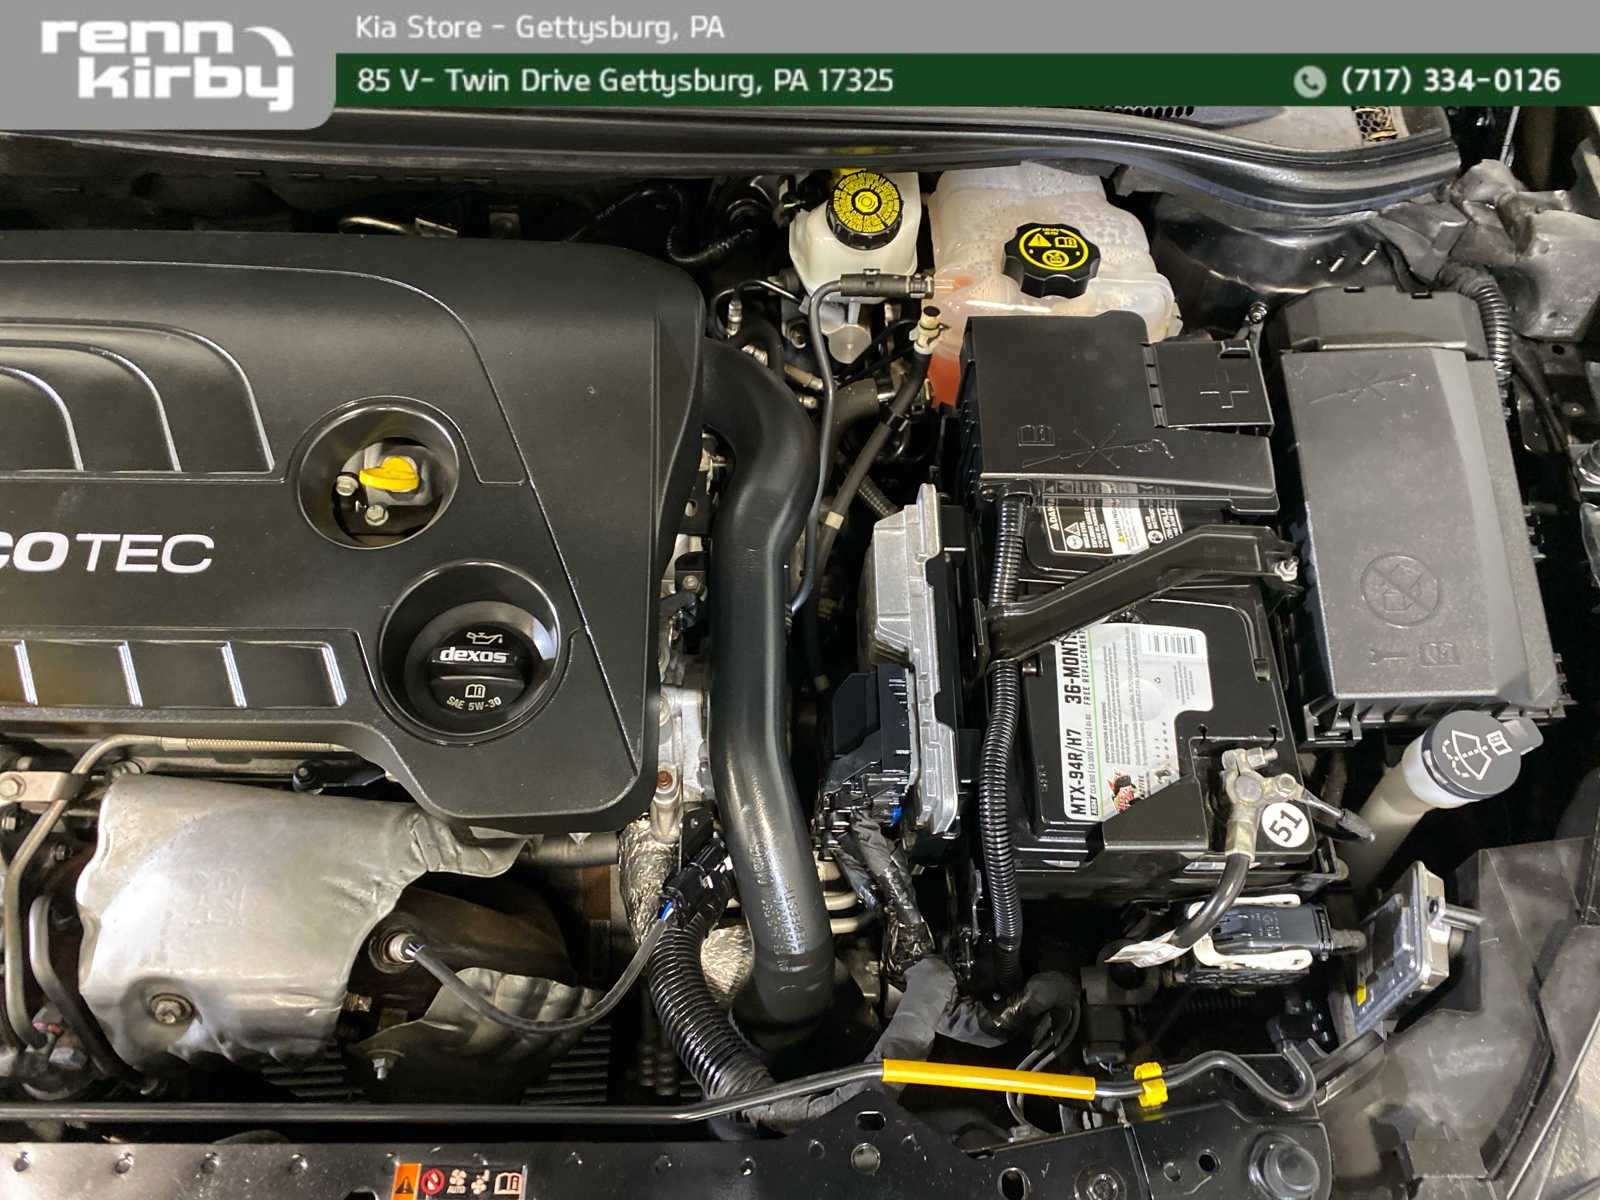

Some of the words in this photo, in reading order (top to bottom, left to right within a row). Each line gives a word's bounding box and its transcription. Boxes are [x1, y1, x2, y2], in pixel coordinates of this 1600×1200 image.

[0, 531, 215, 574] OTEC
[439, 646, 510, 664] dexos
[446, 696, 465, 710] SAE
[468, 696, 502, 711] 5W-30
[1083, 686, 1092, 706] FREE
[1065, 728, 1087, 815] MTX-94R/H7
[1268, 809, 1303, 842] 51
